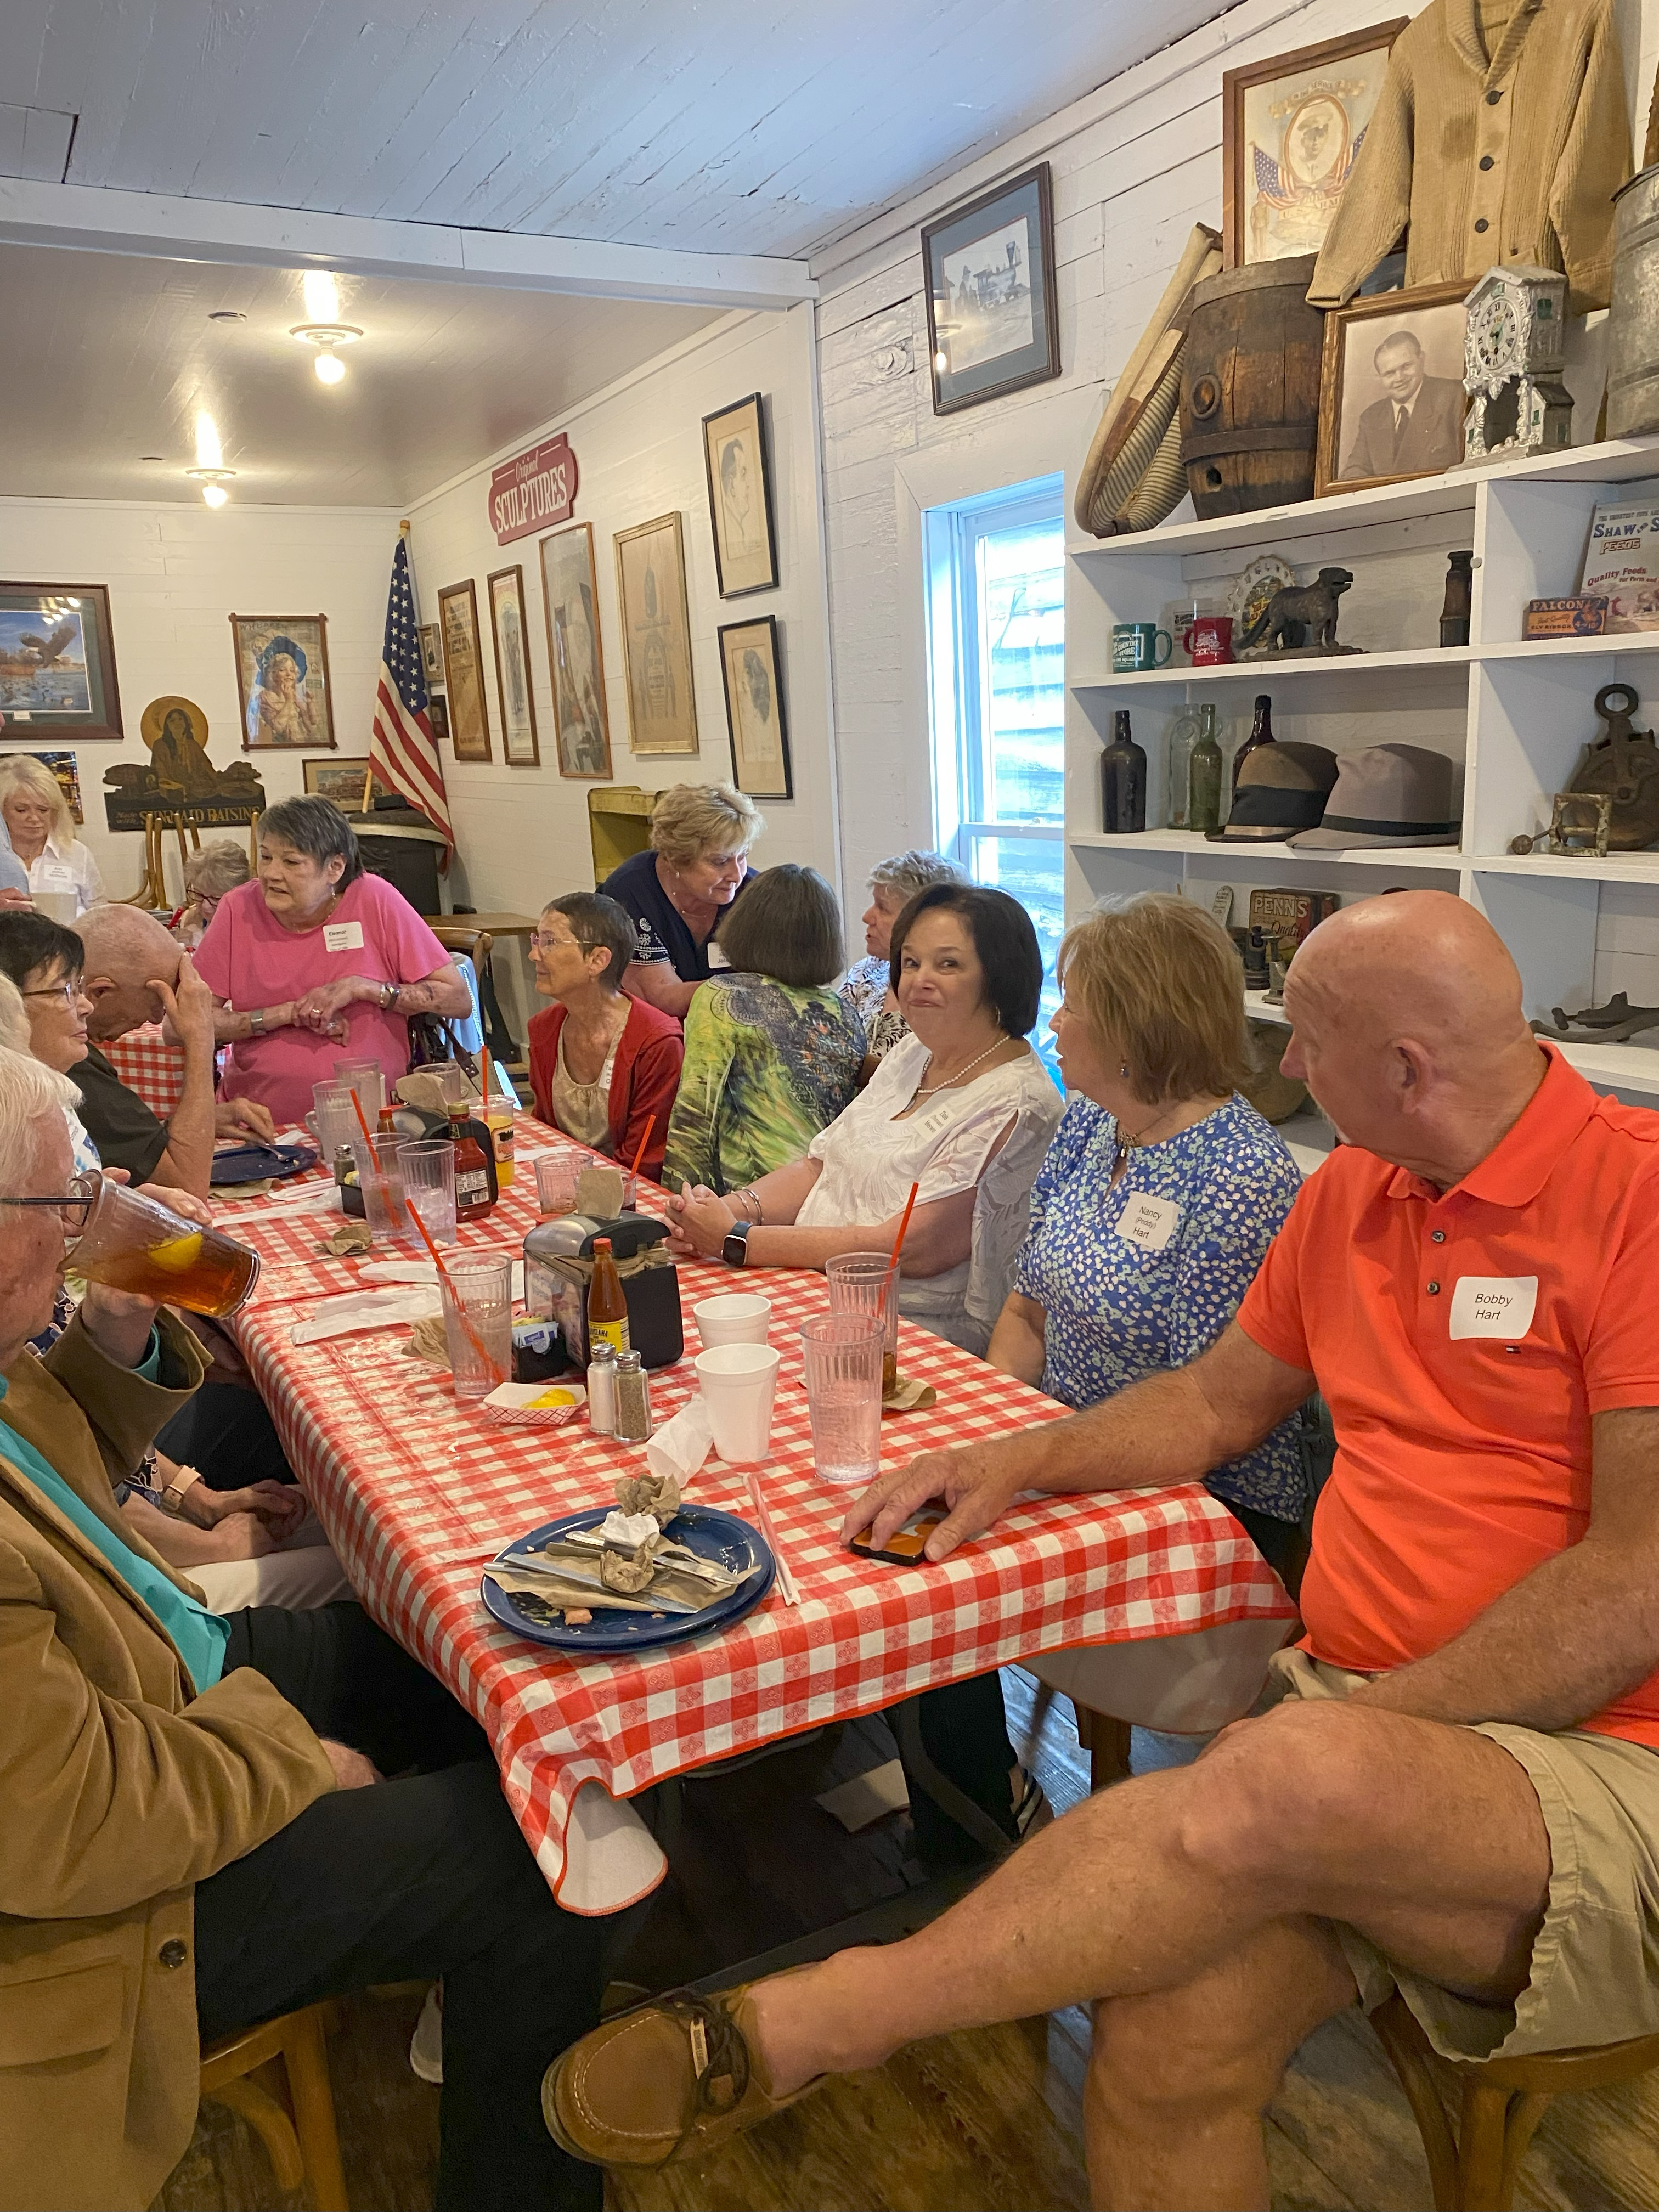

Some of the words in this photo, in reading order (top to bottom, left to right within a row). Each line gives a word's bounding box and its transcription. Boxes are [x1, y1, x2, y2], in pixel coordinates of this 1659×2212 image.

[495, 463, 567, 534] SCULPTURES
[1587, 571, 1620, 586] Quality
[1623, 566, 1646, 575] Feeds
[1532, 600, 1584, 611] FALCON
[1254, 895, 1308, 918] PENN'S
[1138, 1206, 1163, 1221] Nancy
[1132, 1226, 1150, 1239] Hart
[1475, 1293, 1514, 1307] Bobby
[1475, 1309, 1501, 1320] Hart
